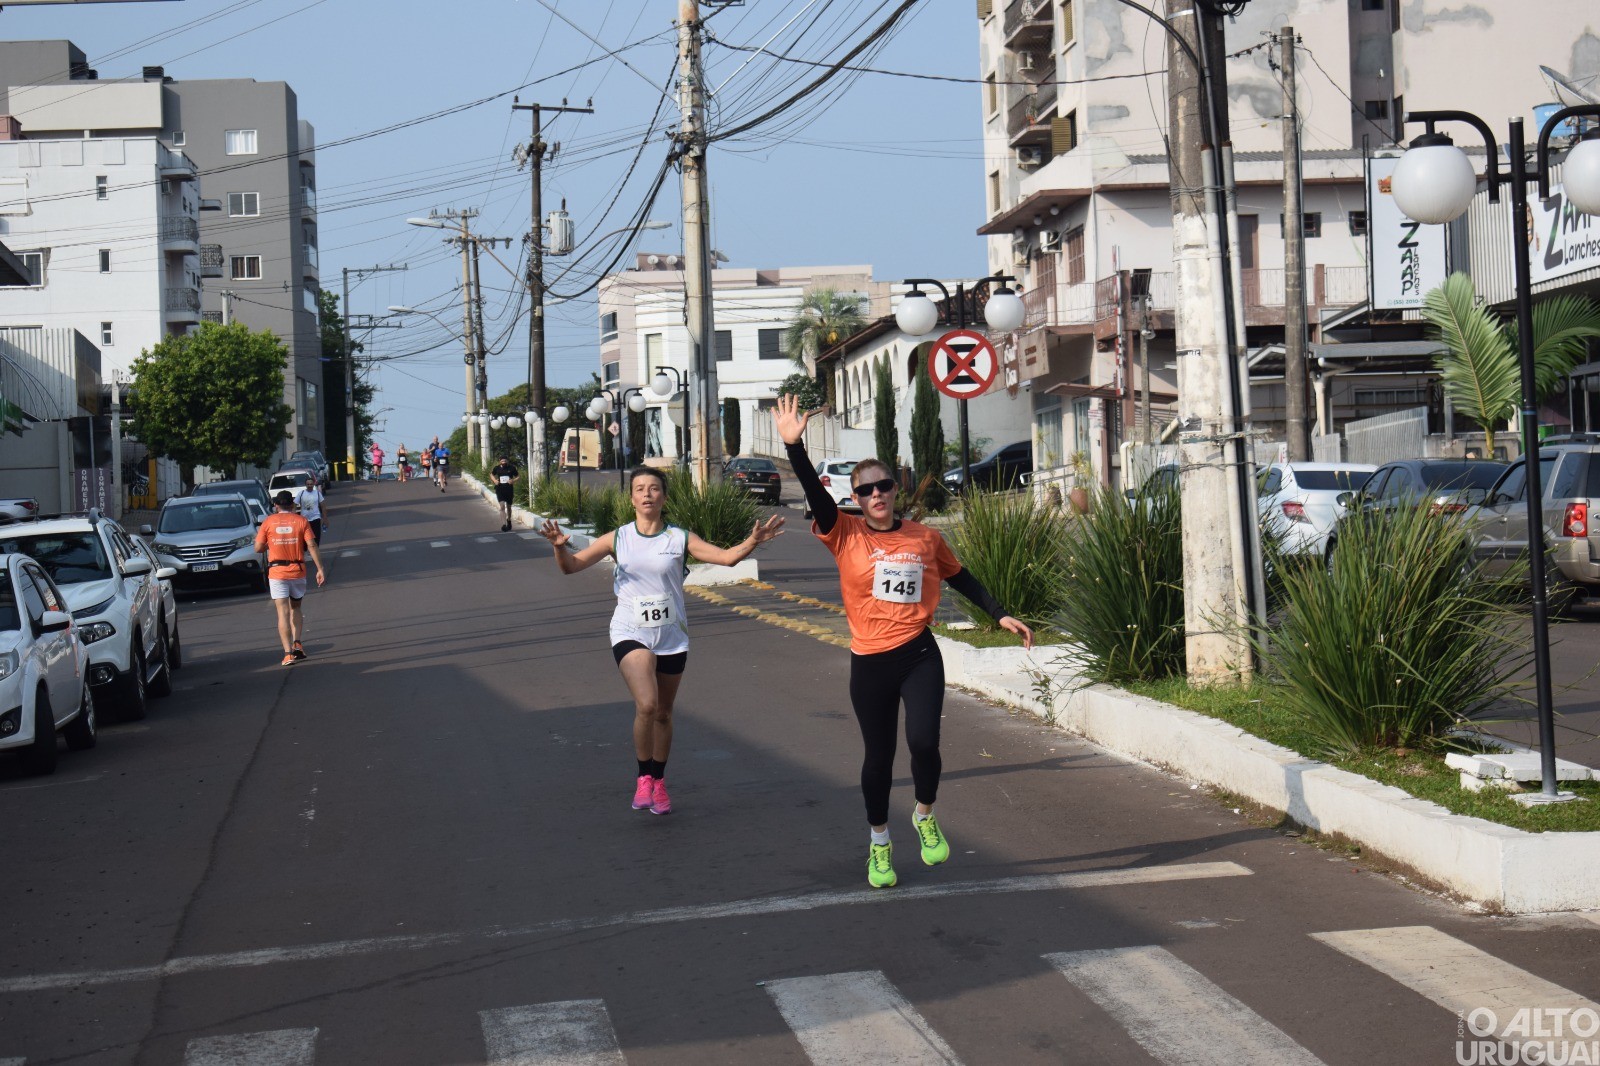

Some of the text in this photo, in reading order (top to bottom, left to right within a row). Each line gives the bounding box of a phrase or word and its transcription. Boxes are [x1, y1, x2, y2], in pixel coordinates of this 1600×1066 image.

[1398, 222, 1420, 295] ZAAP
[1564, 234, 1600, 265] Lanches
[881, 579, 916, 596] 145
[641, 606, 669, 621] 181
